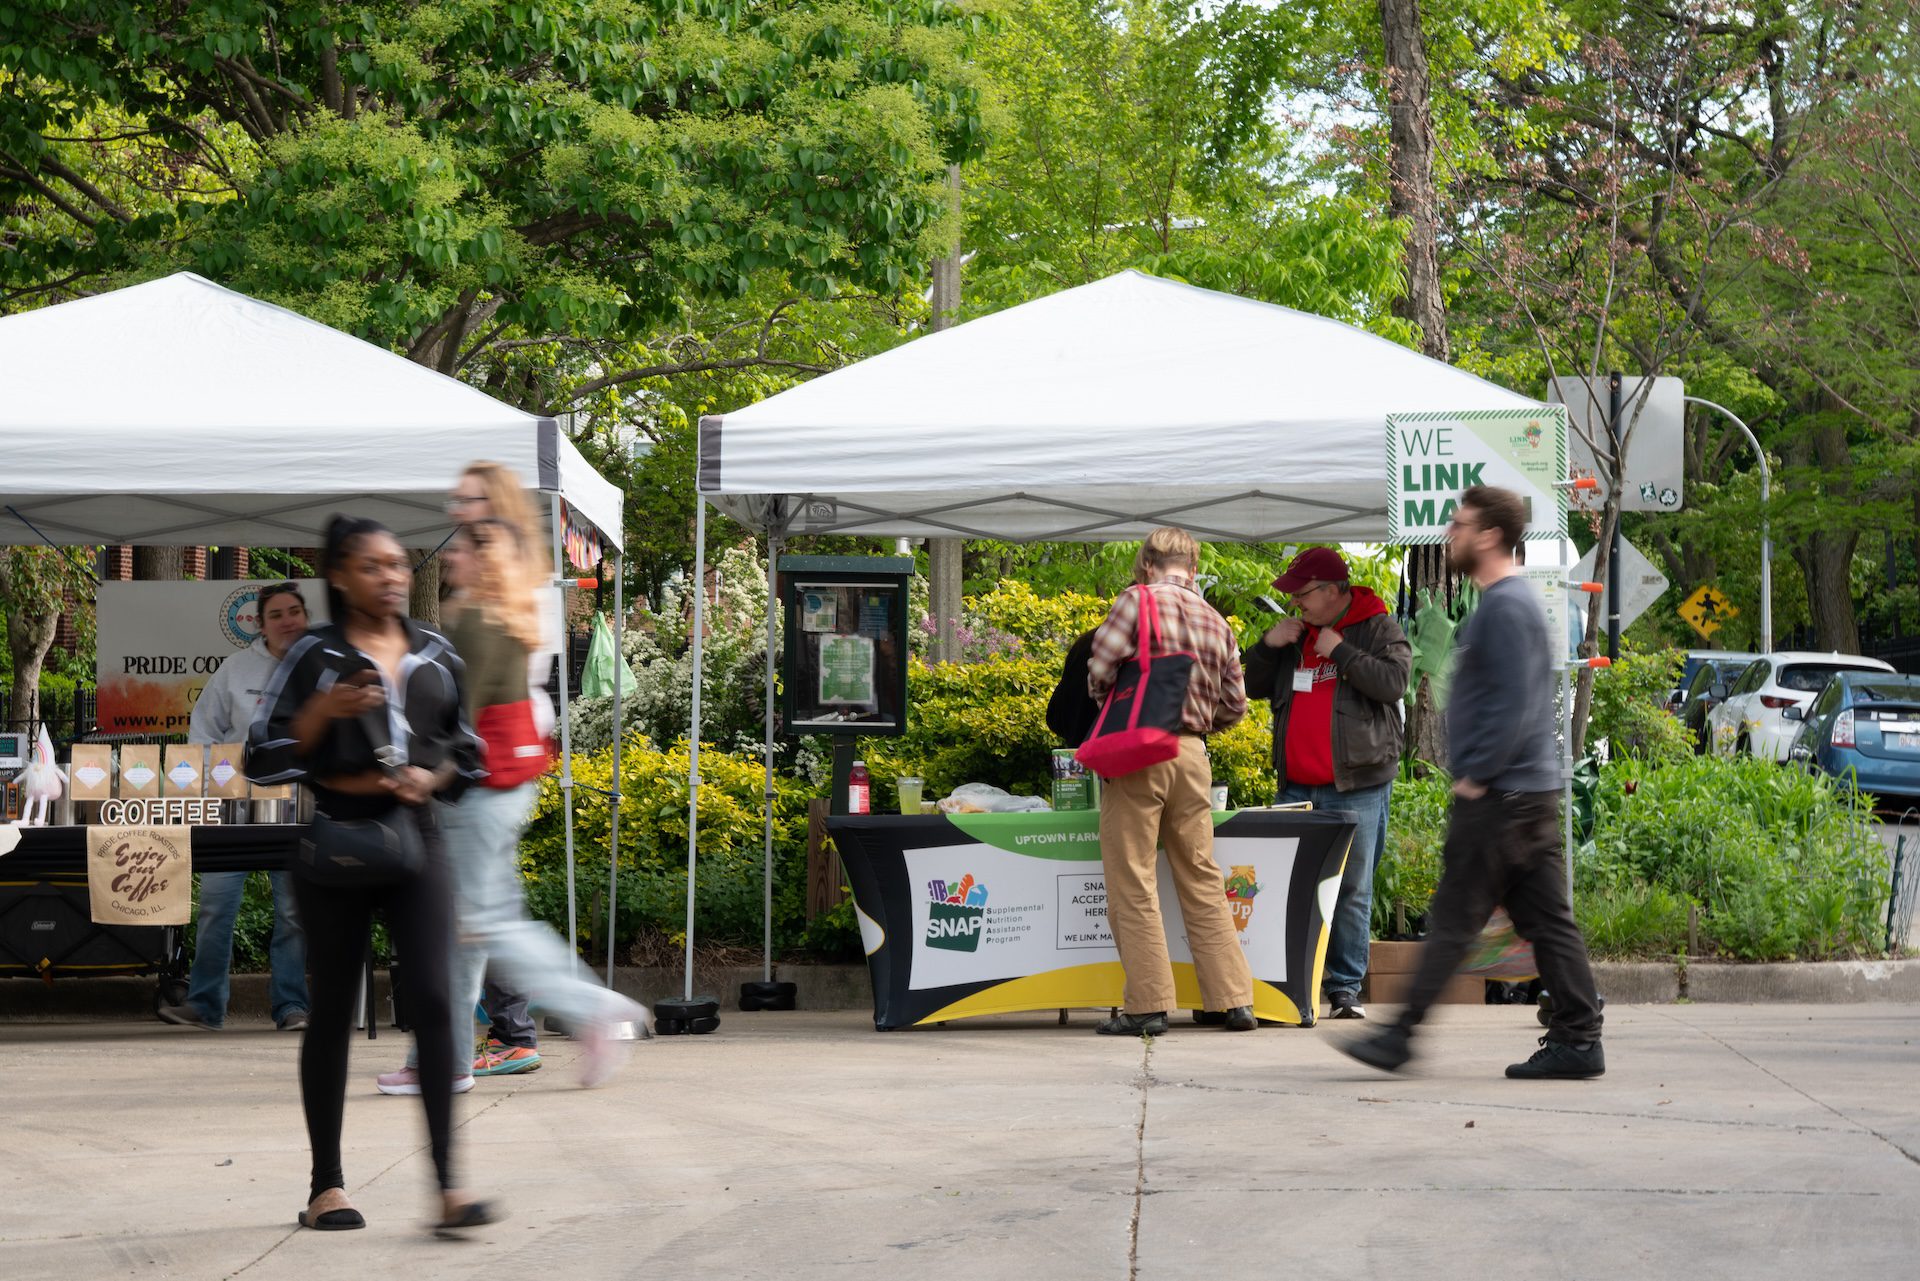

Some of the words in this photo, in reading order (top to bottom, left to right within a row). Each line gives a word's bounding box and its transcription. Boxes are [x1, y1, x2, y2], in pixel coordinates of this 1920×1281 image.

[1401, 428, 1454, 457] WE
[1403, 462, 1488, 492] LINK
[122, 655, 188, 675] PRIDE
[100, 797, 222, 826] COFFEE
[97, 836, 119, 858] PRIDE
[117, 829, 147, 840] COFFEE
[149, 830, 180, 860] ROASTERS
[1015, 833, 1068, 846] UPTOWN
[115, 843, 168, 869] Enjoy
[128, 864, 156, 874] our
[111, 873, 169, 902] Coffee
[986, 903, 1045, 916] Supplemental
[1229, 901, 1252, 919] Up
[926, 914, 983, 938] SNAP
[986, 915, 1023, 925] Nutrition
[986, 924, 1032, 935] Assistance
[986, 934, 1022, 945] Program
[1065, 934, 1078, 942] WE
[1079, 934, 1098, 942] LINK
